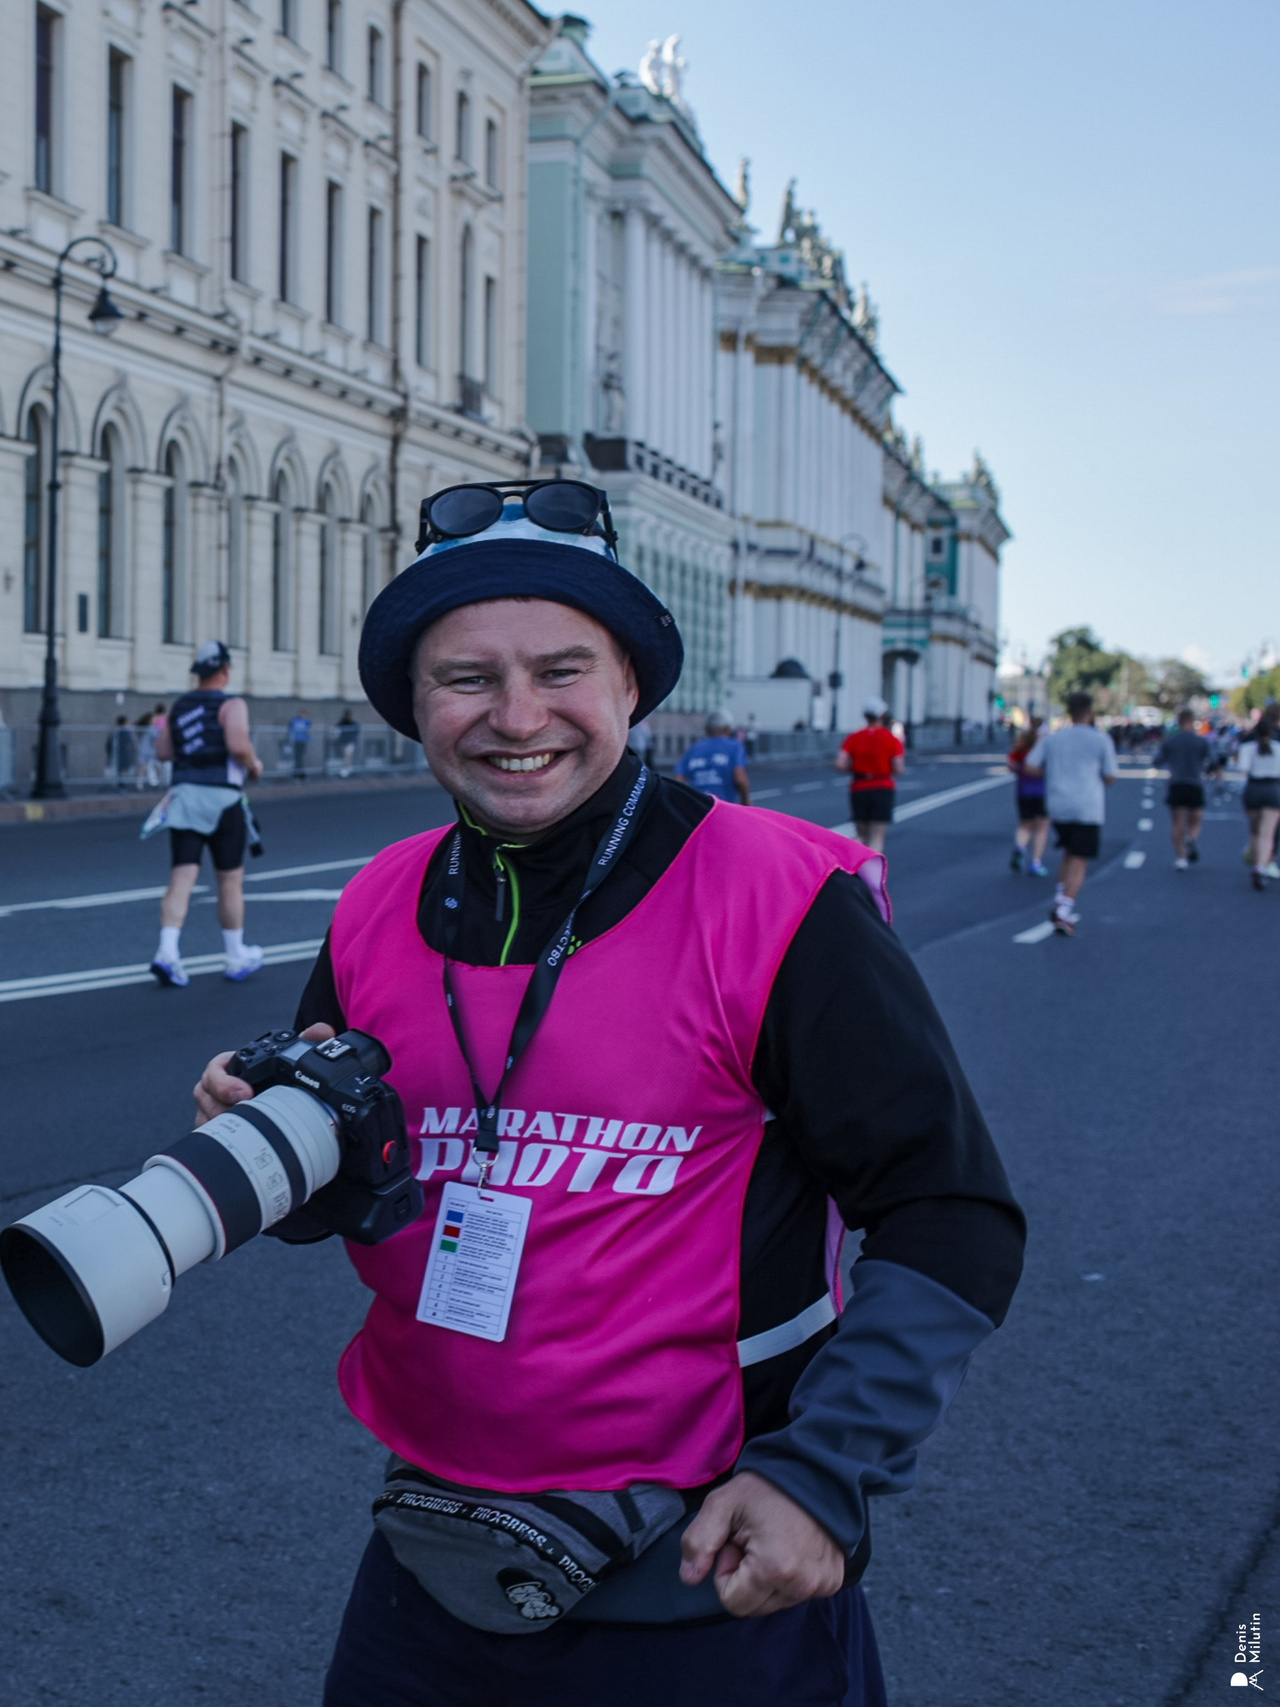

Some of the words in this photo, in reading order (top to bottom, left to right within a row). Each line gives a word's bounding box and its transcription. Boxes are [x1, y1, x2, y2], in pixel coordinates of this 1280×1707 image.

[597, 818, 629, 866] RUNNING
[419, 1107, 702, 1152] MARATHON
[415, 1138, 684, 1195] PHOTO
[397, 1492, 463, 1514] PROGRESS
[470, 1506, 548, 1548] PROGRESS
